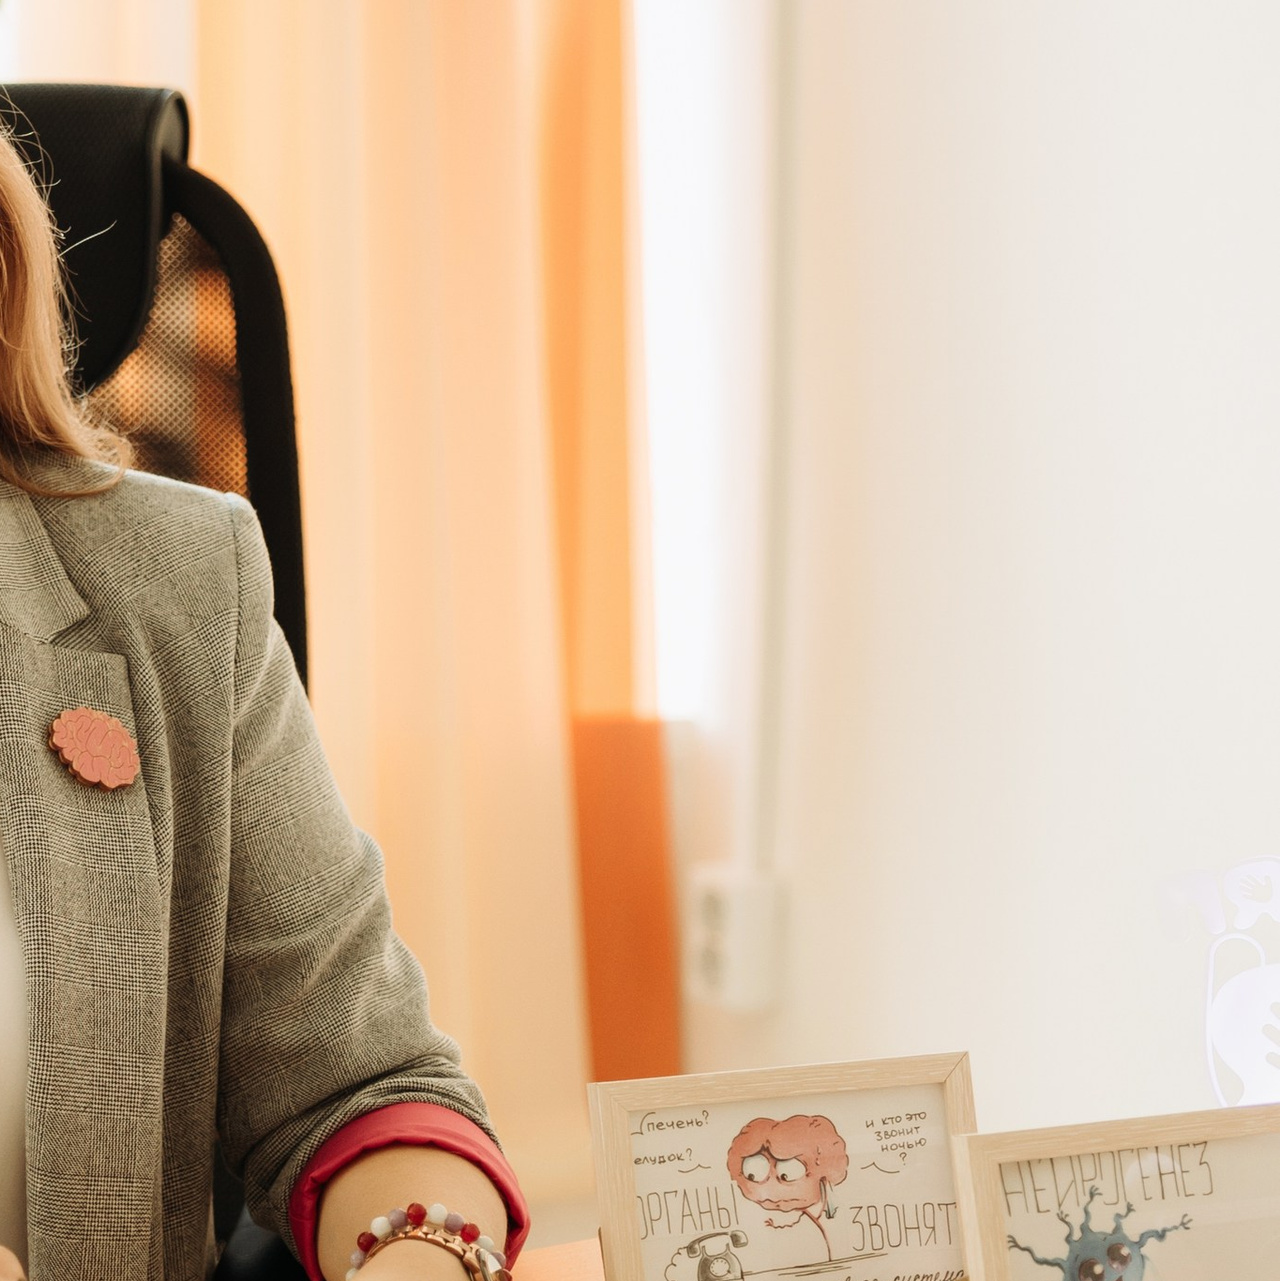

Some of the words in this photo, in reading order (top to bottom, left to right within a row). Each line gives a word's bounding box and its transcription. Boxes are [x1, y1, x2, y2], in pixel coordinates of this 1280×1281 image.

[647, 1110, 709, 1132] печень?
[881, 1115, 902, 1125] кто
[905, 1111, 927, 1121] это
[874, 1126, 920, 1141] звонит
[881, 1137, 927, 1152] ночью
[633, 1148, 692, 1165] елудок?
[849, 1201, 958, 1252] ЗВОНЯТ
